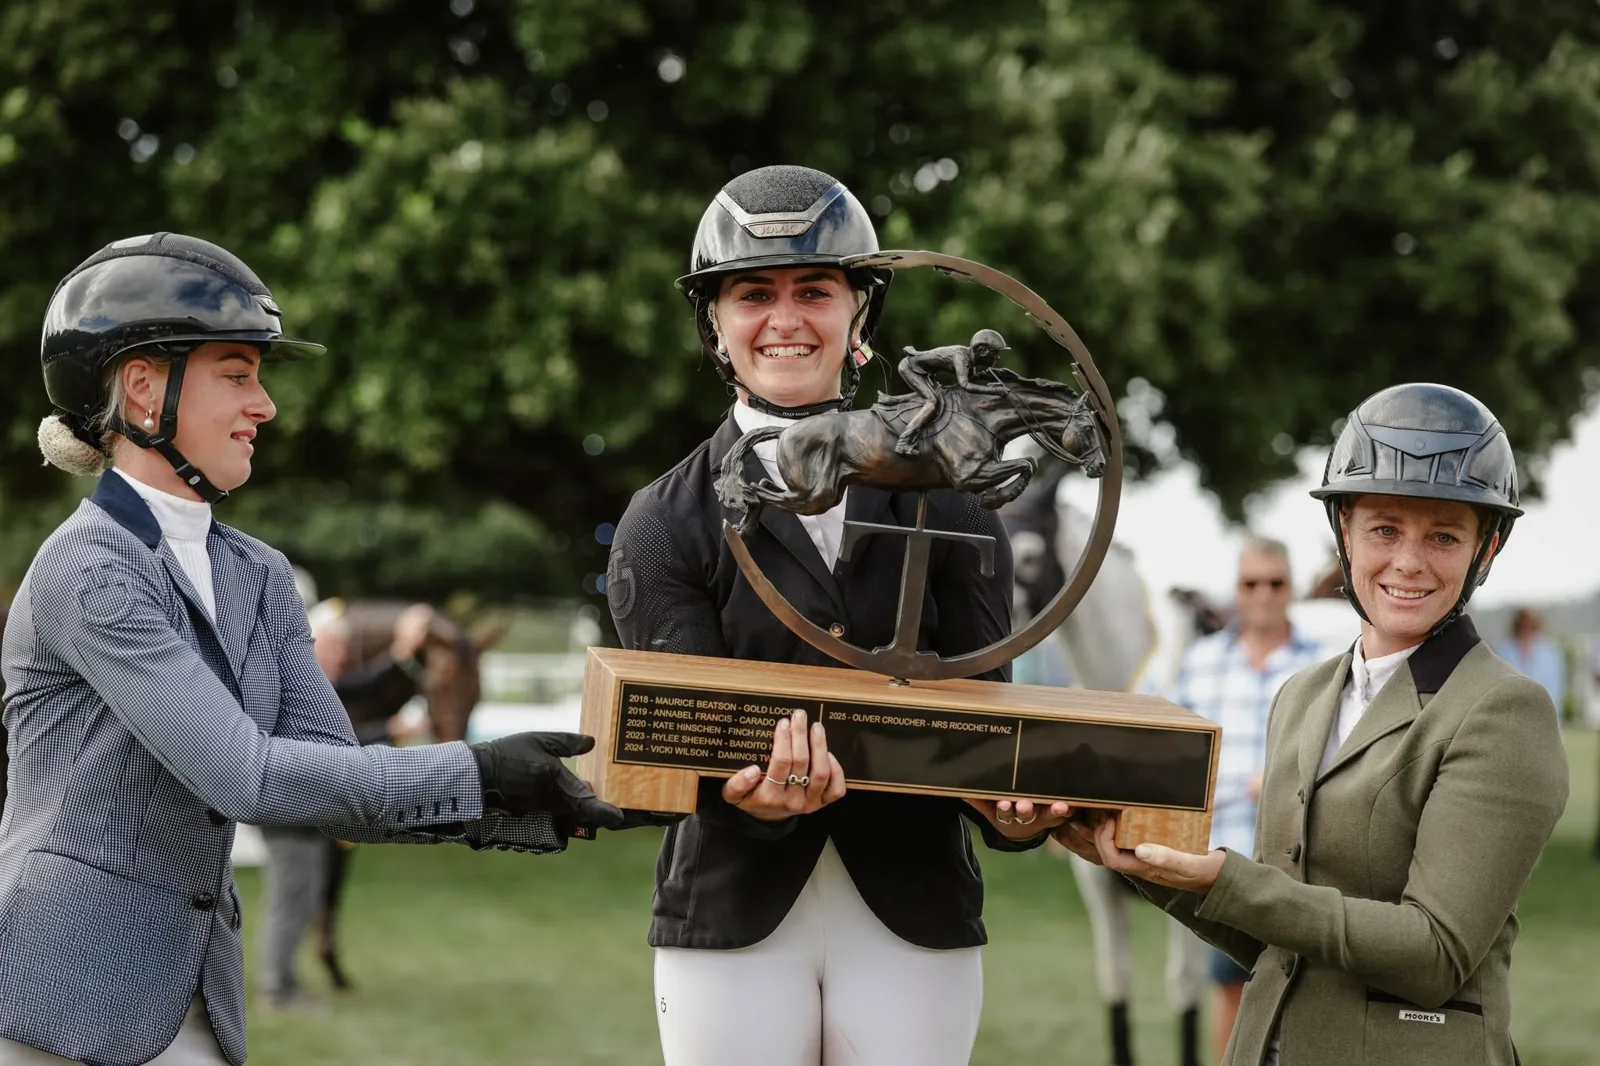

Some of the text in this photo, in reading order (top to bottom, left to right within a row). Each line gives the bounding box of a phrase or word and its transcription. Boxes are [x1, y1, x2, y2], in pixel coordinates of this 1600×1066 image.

[629, 695, 648, 703] 2018
[655, 697, 694, 708] MAURICE
[696, 700, 736, 711] BEATSON
[744, 704, 768, 714] GOLD
[628, 707, 648, 715] 2019
[653, 709, 694, 720] ANNABEL
[695, 713, 732, 723] FRANCIS
[739, 717, 776, 727] CARADO
[829, 712, 846, 720] 2025
[852, 714, 880, 723] OLIVER
[882, 716, 925, 727] CROUCHER
[932, 720, 948, 728] NRS
[949, 722, 988, 732] RICOCHET
[990, 726, 1012, 734] MVNZ
[627, 719, 646, 728] 2020
[652, 721, 674, 730] KATE
[676, 724, 721, 734] HINSCHEN
[728, 728, 753, 737] FINCH
[625, 731, 645, 740] 2023
[652, 733, 679, 742] RYLEE
[681, 736, 723, 746] SHEEHAN
[730, 740, 767, 750] BANDITO
[624, 743, 643, 752] 2024
[650, 745, 673, 754] VICKI
[674, 747, 708, 757] WILSON
[718, 752, 757, 762] DAMINOS
[1404, 1013, 1441, 1022] MOORE'S
